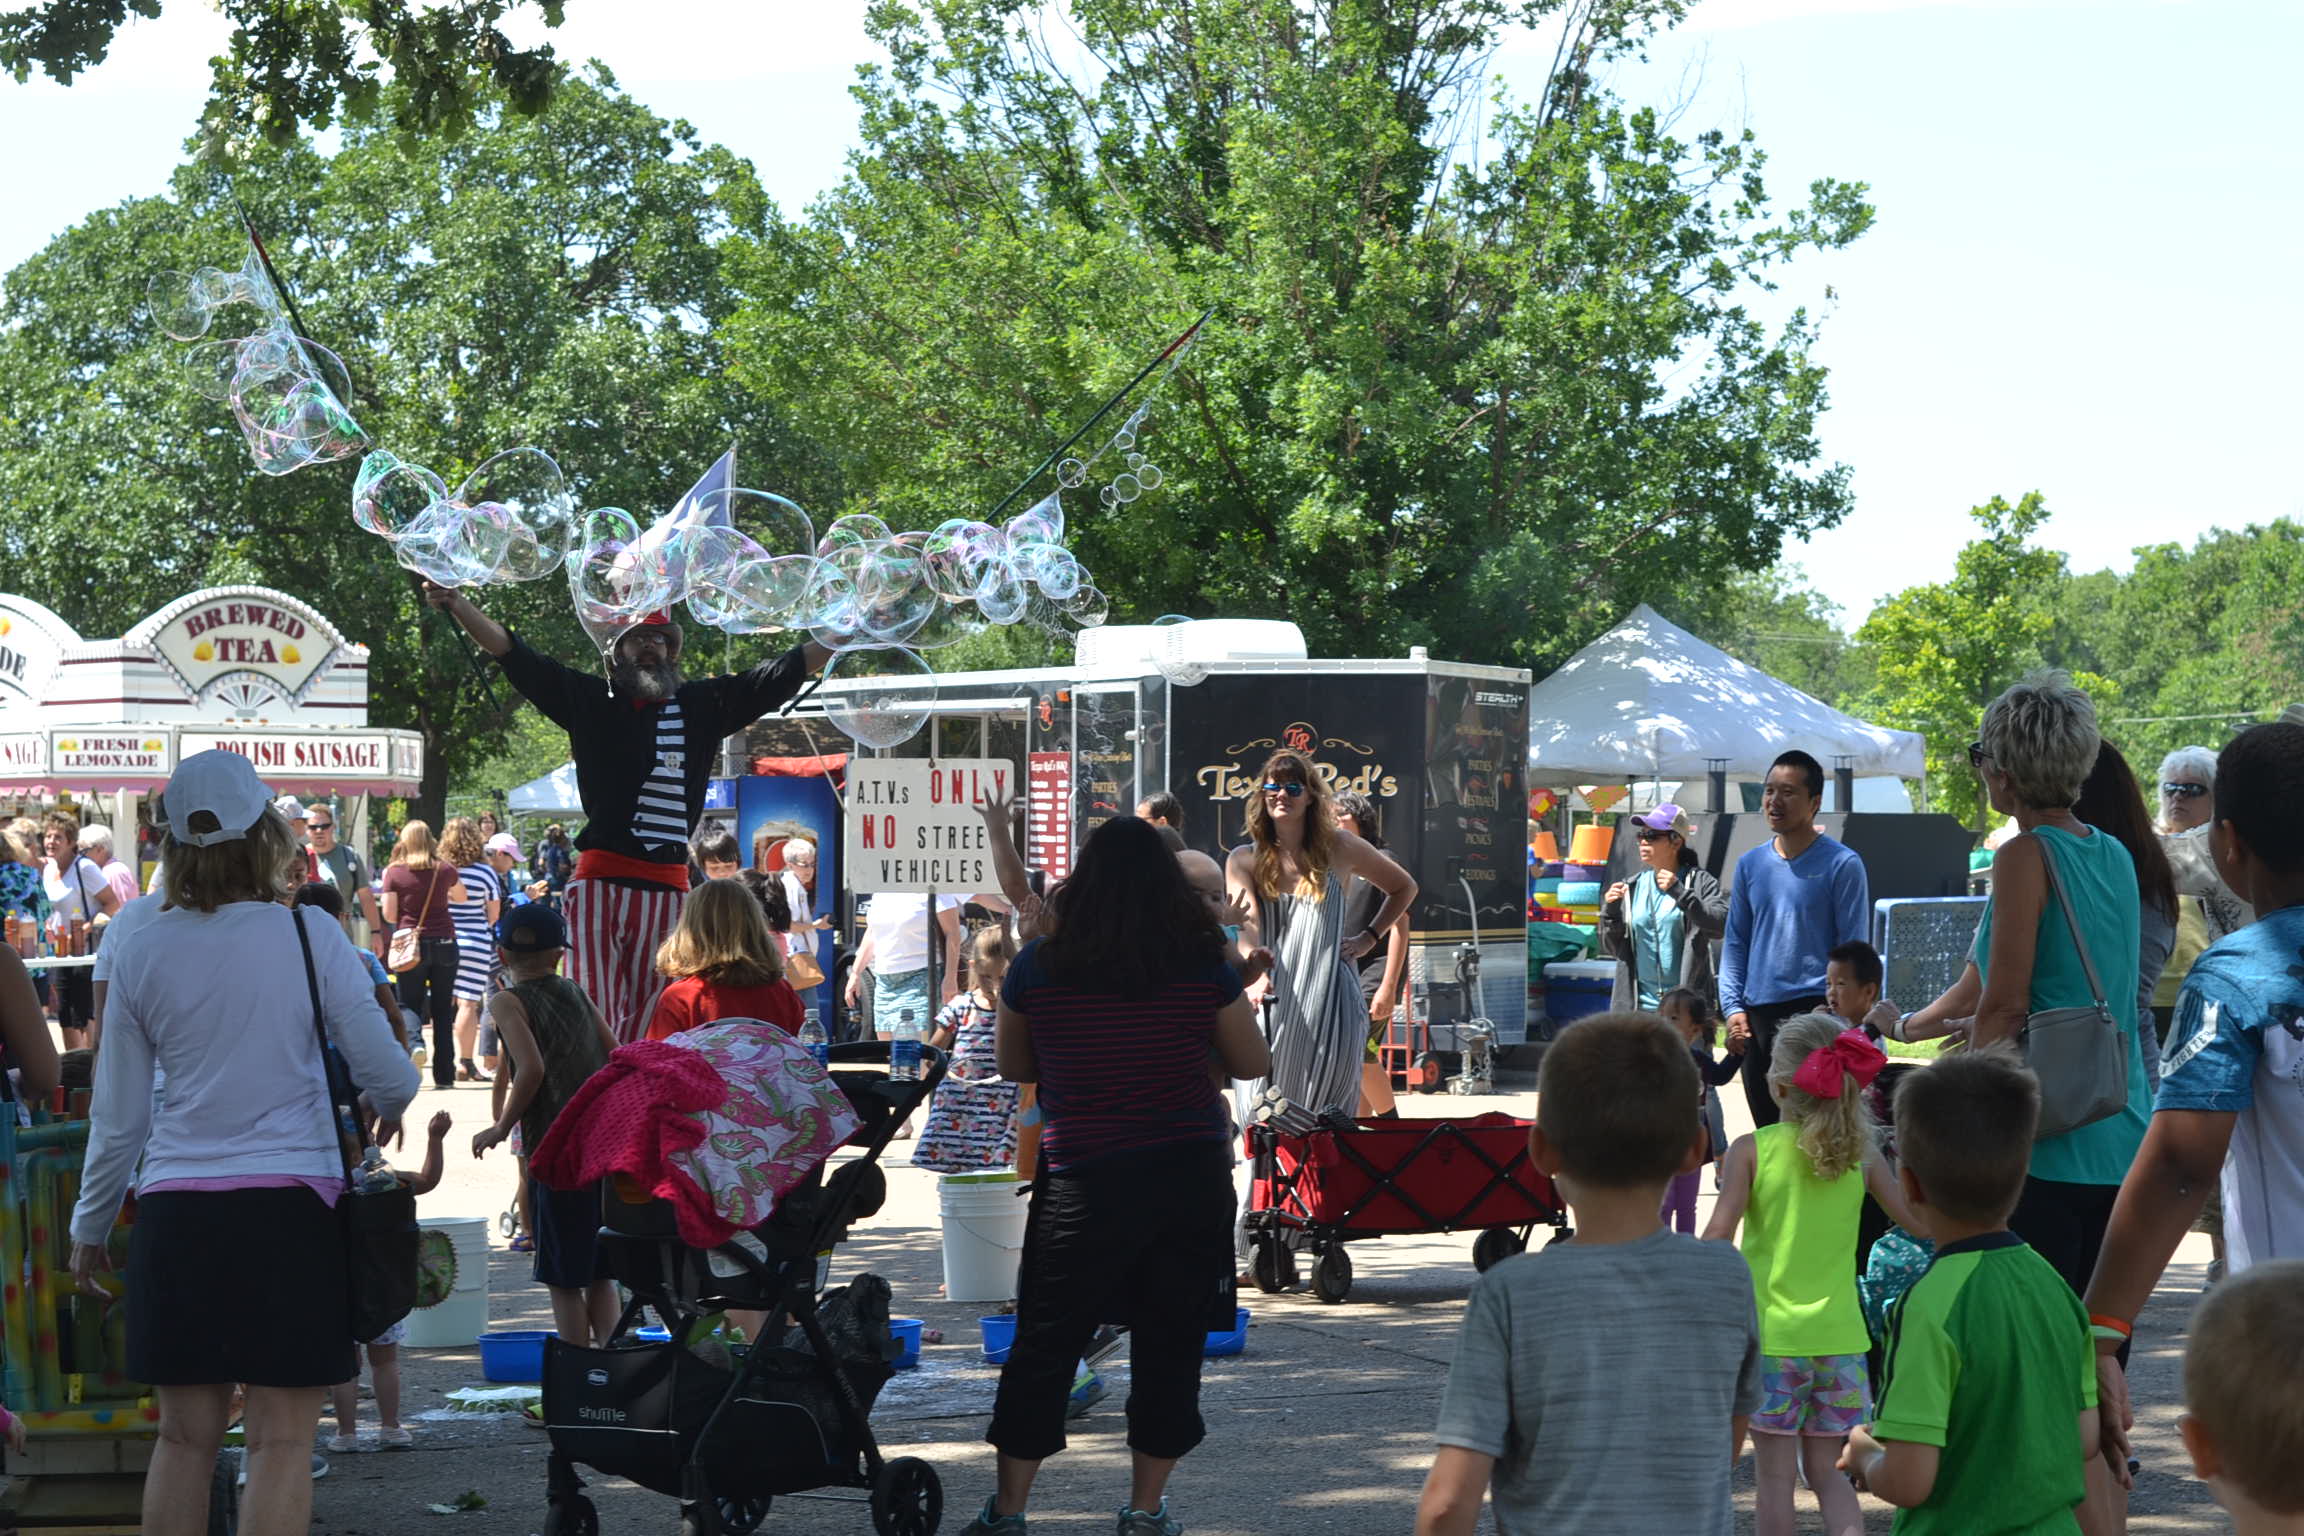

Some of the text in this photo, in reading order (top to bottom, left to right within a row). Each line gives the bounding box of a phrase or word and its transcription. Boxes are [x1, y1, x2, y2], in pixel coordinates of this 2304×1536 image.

[183, 603, 305, 641] BREWED
[214, 637, 279, 664] TEA
[83, 738, 139, 751] FRESH
[295, 742, 381, 768] SAUSAGE
[64, 754, 158, 767] LEMONADE
[931, 769, 1005, 804] ONLY
[1196, 762, 1262, 801] Tex
[863, 814, 985, 850] NO STREE
[881, 859, 983, 884] VEHICLES
